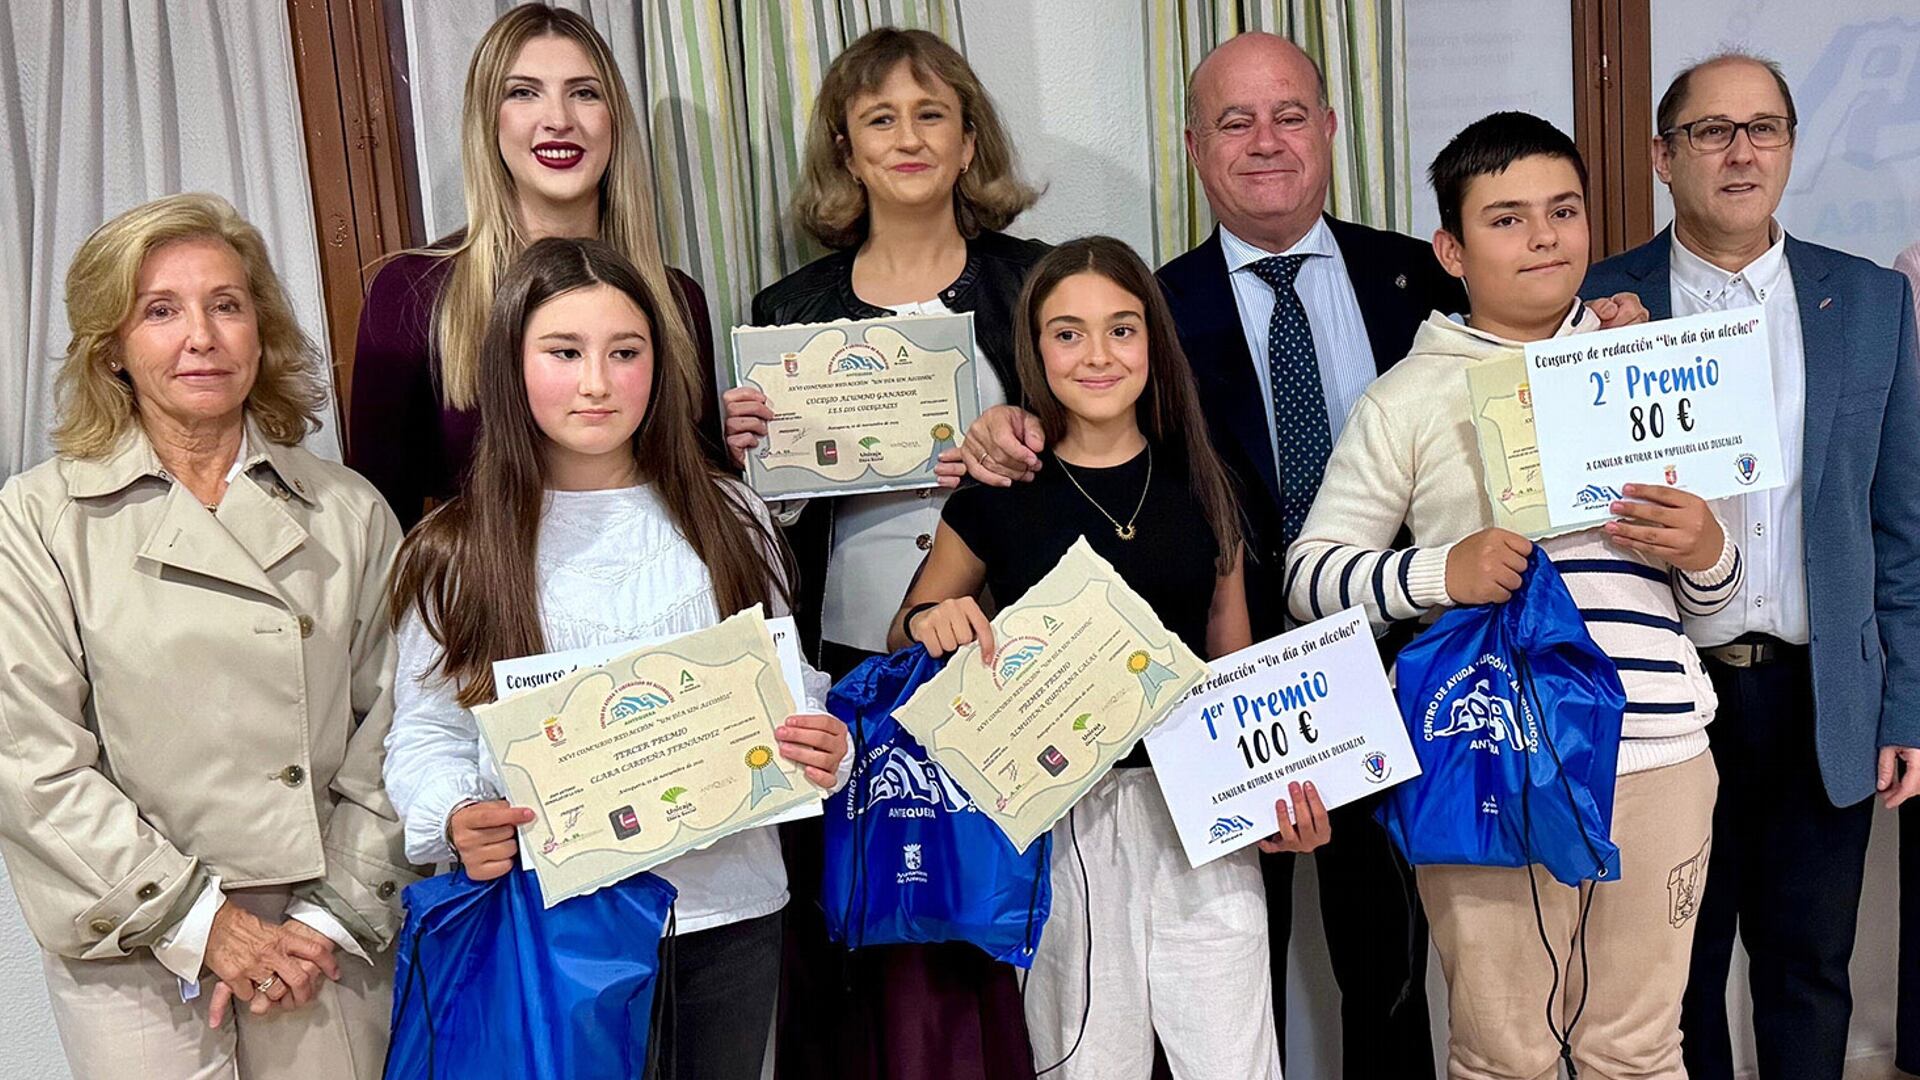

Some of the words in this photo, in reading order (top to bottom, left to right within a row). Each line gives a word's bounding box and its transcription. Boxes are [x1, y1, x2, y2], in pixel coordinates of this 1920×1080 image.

[1587, 346, 1599, 360] de
[1602, 337, 1653, 357] redacción
[1700, 328, 1715, 343] sin
[1626, 356, 1719, 399] Premio
[1629, 402, 1664, 442] 80
[1677, 398, 1694, 433] €
[1586, 462, 1592, 471] A
[1593, 456, 1623, 470] CANJEAR
[1624, 450, 1652, 464] RETIRAR
[1653, 448, 1663, 459] EN
[1698, 441, 1709, 452] LAS
[1710, 434, 1743, 449] DESCALZAS
[1044, 661, 1071, 688] PREMIO
[1206, 662, 1256, 690] redacción
[1301, 640, 1317, 656] sin
[1233, 671, 1328, 728] Premio
[1424, 701, 1439, 741] CENTRO
[1435, 686, 1449, 701] DE
[1446, 665, 1476, 690] AYUDA
[590, 767, 620, 784] CLARA
[667, 728, 720, 757] FERNÁNDEZ
[613, 741, 650, 760] TERCER
[651, 727, 688, 746] PREMIO
[1237, 722, 1288, 769] 100
[1299, 710, 1319, 744] €
[1212, 796, 1219, 805] A
[1217, 783, 1247, 802] CANJEAR
[1247, 772, 1274, 790] RETIRAR
[1274, 767, 1285, 779] EN
[1317, 749, 1331, 762] LAS
[1331, 735, 1366, 756] DESCALZAS
[847, 778, 857, 820] CENTRO
